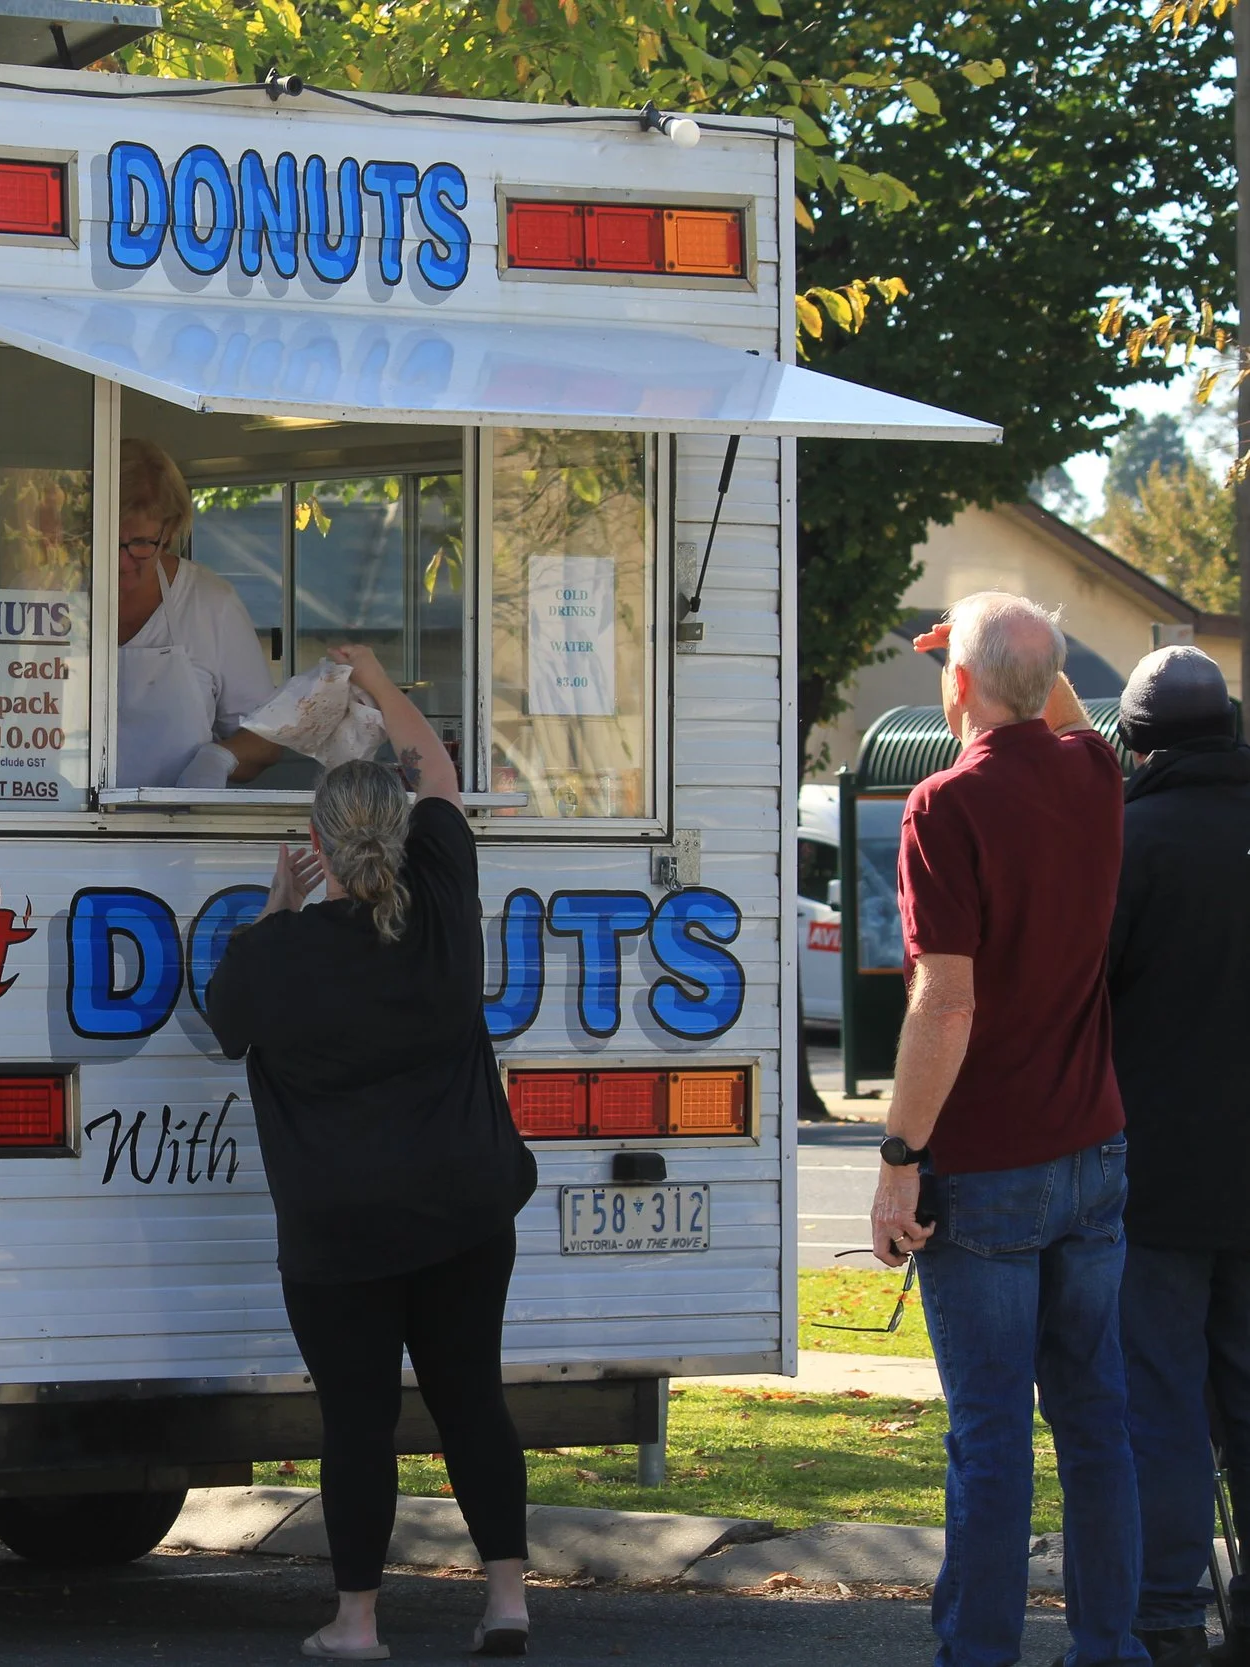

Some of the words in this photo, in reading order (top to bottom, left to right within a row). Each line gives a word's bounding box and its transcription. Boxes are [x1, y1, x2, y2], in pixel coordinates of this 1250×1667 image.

[108, 140, 470, 291] DONUTS
[555, 589, 588, 601] COLD
[548, 605, 596, 617] DRINKS
[550, 641, 594, 652] WATER
[7, 656, 70, 680] each
[26, 757, 46, 768] GST
[12, 781, 59, 798] BAGS
[84, 1091, 240, 1185] With
[626, 1239, 643, 1250] ON
[645, 1238, 668, 1249] THE
[670, 1236, 702, 1249] MOVE
